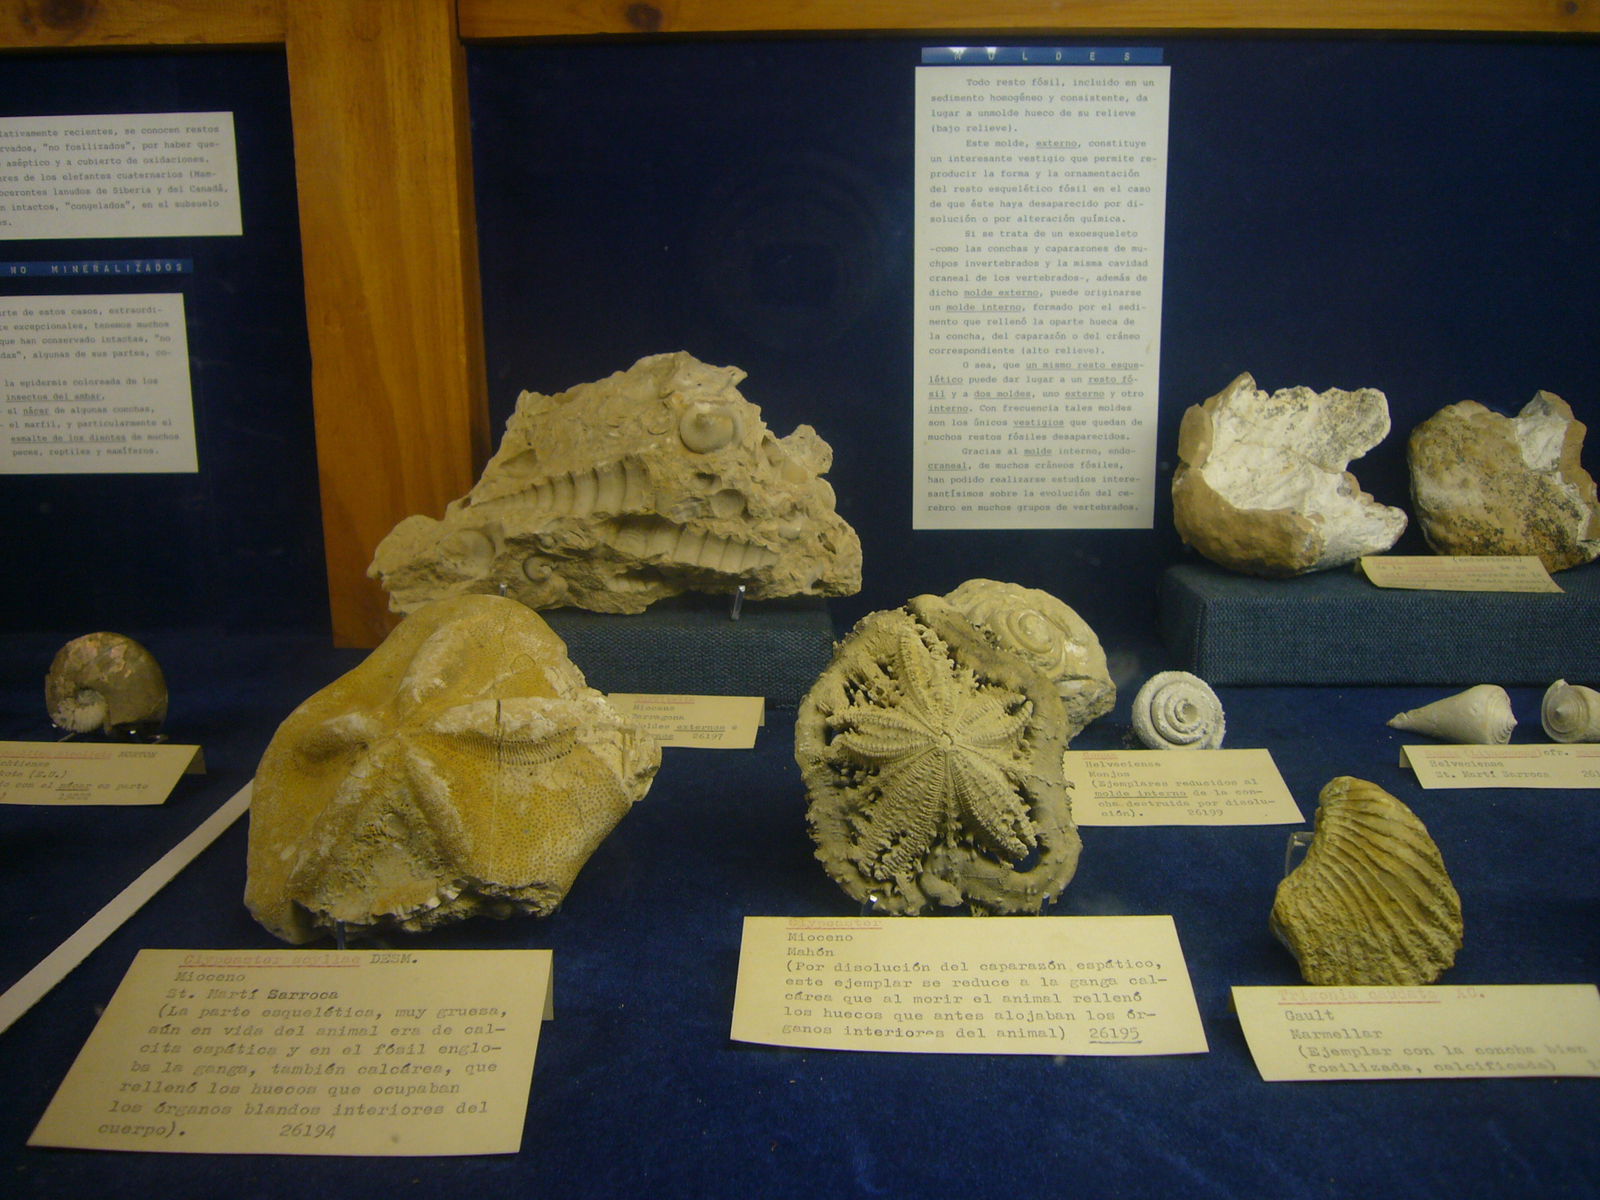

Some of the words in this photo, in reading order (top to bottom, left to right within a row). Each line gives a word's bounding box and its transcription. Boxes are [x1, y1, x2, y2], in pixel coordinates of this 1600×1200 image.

[966, 76, 991, 86] Todo
[996, 77, 1026, 86] resto
[1031, 76, 1065, 88] fósil,
[1073, 76, 1120, 86] incluido
[930, 92, 985, 102] sedimento
[990, 92, 1043, 104] homogéneo
[1060, 93, 1129, 103] consistente,
[931, 107, 961, 120] lugar
[978, 107, 1020, 117] unmolde
[1024, 107, 1055, 117] hueco
[1095, 107, 1136, 117] relieve
[931, 122, 961, 135] (bajo
[966, 122, 1018, 135] relieve).
[966, 138, 990, 148] Este
[994, 138, 1029, 149] molde,
[1035, 138, 1081, 149] externo,
[1088, 138, 1147, 150] constituye
[10, 265, 28, 275] NO
[51, 262, 184, 275] MINERALIZADOS
[787, 929, 854, 942] Mioceno
[786, 943, 835, 956] Mahón
[368, 951, 424, 964] DESM.
[786, 959, 825, 975] (Por
[834, 958, 931, 972] disolución
[940, 958, 969, 971] del
[979, 957, 1067, 974] caparazón
[1076, 957, 1162, 974] espático,
[173, 969, 246, 982] Mioceno
[785, 976, 823, 988] este
[834, 974, 913, 991] ejemplar
[922, 979, 941, 988] se
[952, 974, 1010, 988] reduce
[1020, 979, 1030, 987] a
[1040, 974, 1059, 987] la
[1070, 978, 1118, 990] ganga
[1128, 974, 1168, 987] cal-
[166, 986, 195, 1000] St.
[206, 986, 259, 1000] Martí
[266, 986, 339, 1000] Sarroca
[784, 990, 833, 1003] cárea
[843, 994, 872, 1006] que
[883, 990, 902, 1003] al
[913, 991, 963, 1003] morir
[973, 990, 992, 1003] el
[1002, 990, 1062, 1003] animal
[1072, 990, 1143, 1003] rellenó
[158, 1004, 188, 1021] (La
[198, 1005, 251, 1021] parte
[261, 1004, 383, 1020] esquelética,
[394, 1008, 428, 1020] muy
[436, 1008, 507, 1020] gruesa,
[784, 1005, 812, 1018] los
[823, 1005, 883, 1019] huecos
[893, 1010, 924, 1022] que
[934, 1007, 984, 1020] antes
[994, 1007, 1076, 1024] alojaban
[1085, 1007, 1115, 1021] los
[1126, 1008, 1157, 1021] ór-
[1284, 1008, 1335, 1021] Gault
[148, 1023, 182, 1036] aún
[190, 1027, 212, 1036] en
[224, 1023, 264, 1036] vida
[274, 1023, 305, 1036] del
[316, 1022, 379, 1036] animal
[390, 1027, 421, 1036] era
[431, 1022, 453, 1036] de
[464, 1022, 507, 1035] cal-
[782, 1026, 832, 1039] ganos
[844, 1023, 945, 1037] interiores
[955, 1024, 986, 1037] del
[996, 1024, 1070, 1041] animal)
[1088, 1025, 1140, 1039] 26195
[1290, 1026, 1383, 1039] Marmellar
[140, 1042, 182, 1054] cita
[192, 1041, 277, 1057] espática
[287, 1045, 301, 1057] y
[310, 1045, 331, 1054] en
[342, 1041, 362, 1054] el
[373, 1041, 426, 1054] fósil
[438, 1041, 502, 1057] englo-
[1298, 1044, 1392, 1060] (Ejemplar
[1402, 1047, 1435, 1056] con
[1442, 1043, 1465, 1055] la
[130, 1061, 151, 1074] ba
[161, 1061, 184, 1074] la
[192, 1065, 256, 1077] ganga,
[271, 1061, 346, 1074] también
[357, 1060, 452, 1075] calcárea,
[465, 1065, 498, 1077] que
[1306, 1059, 1422, 1073] fosilizada,
[119, 1081, 197, 1094] rellenó
[207, 1081, 241, 1094] los
[250, 1081, 318, 1094] huecos
[328, 1085, 361, 1097] que
[372, 1080, 460, 1097] ocupaban
[108, 1101, 144, 1114] los
[154, 1101, 233, 1118] órganos
[244, 1101, 321, 1114] blandos
[332, 1102, 445, 1114] interiores
[455, 1101, 488, 1114] del
[98, 1121, 187, 1138] cuerpo).
[279, 1122, 337, 1136] 26194
